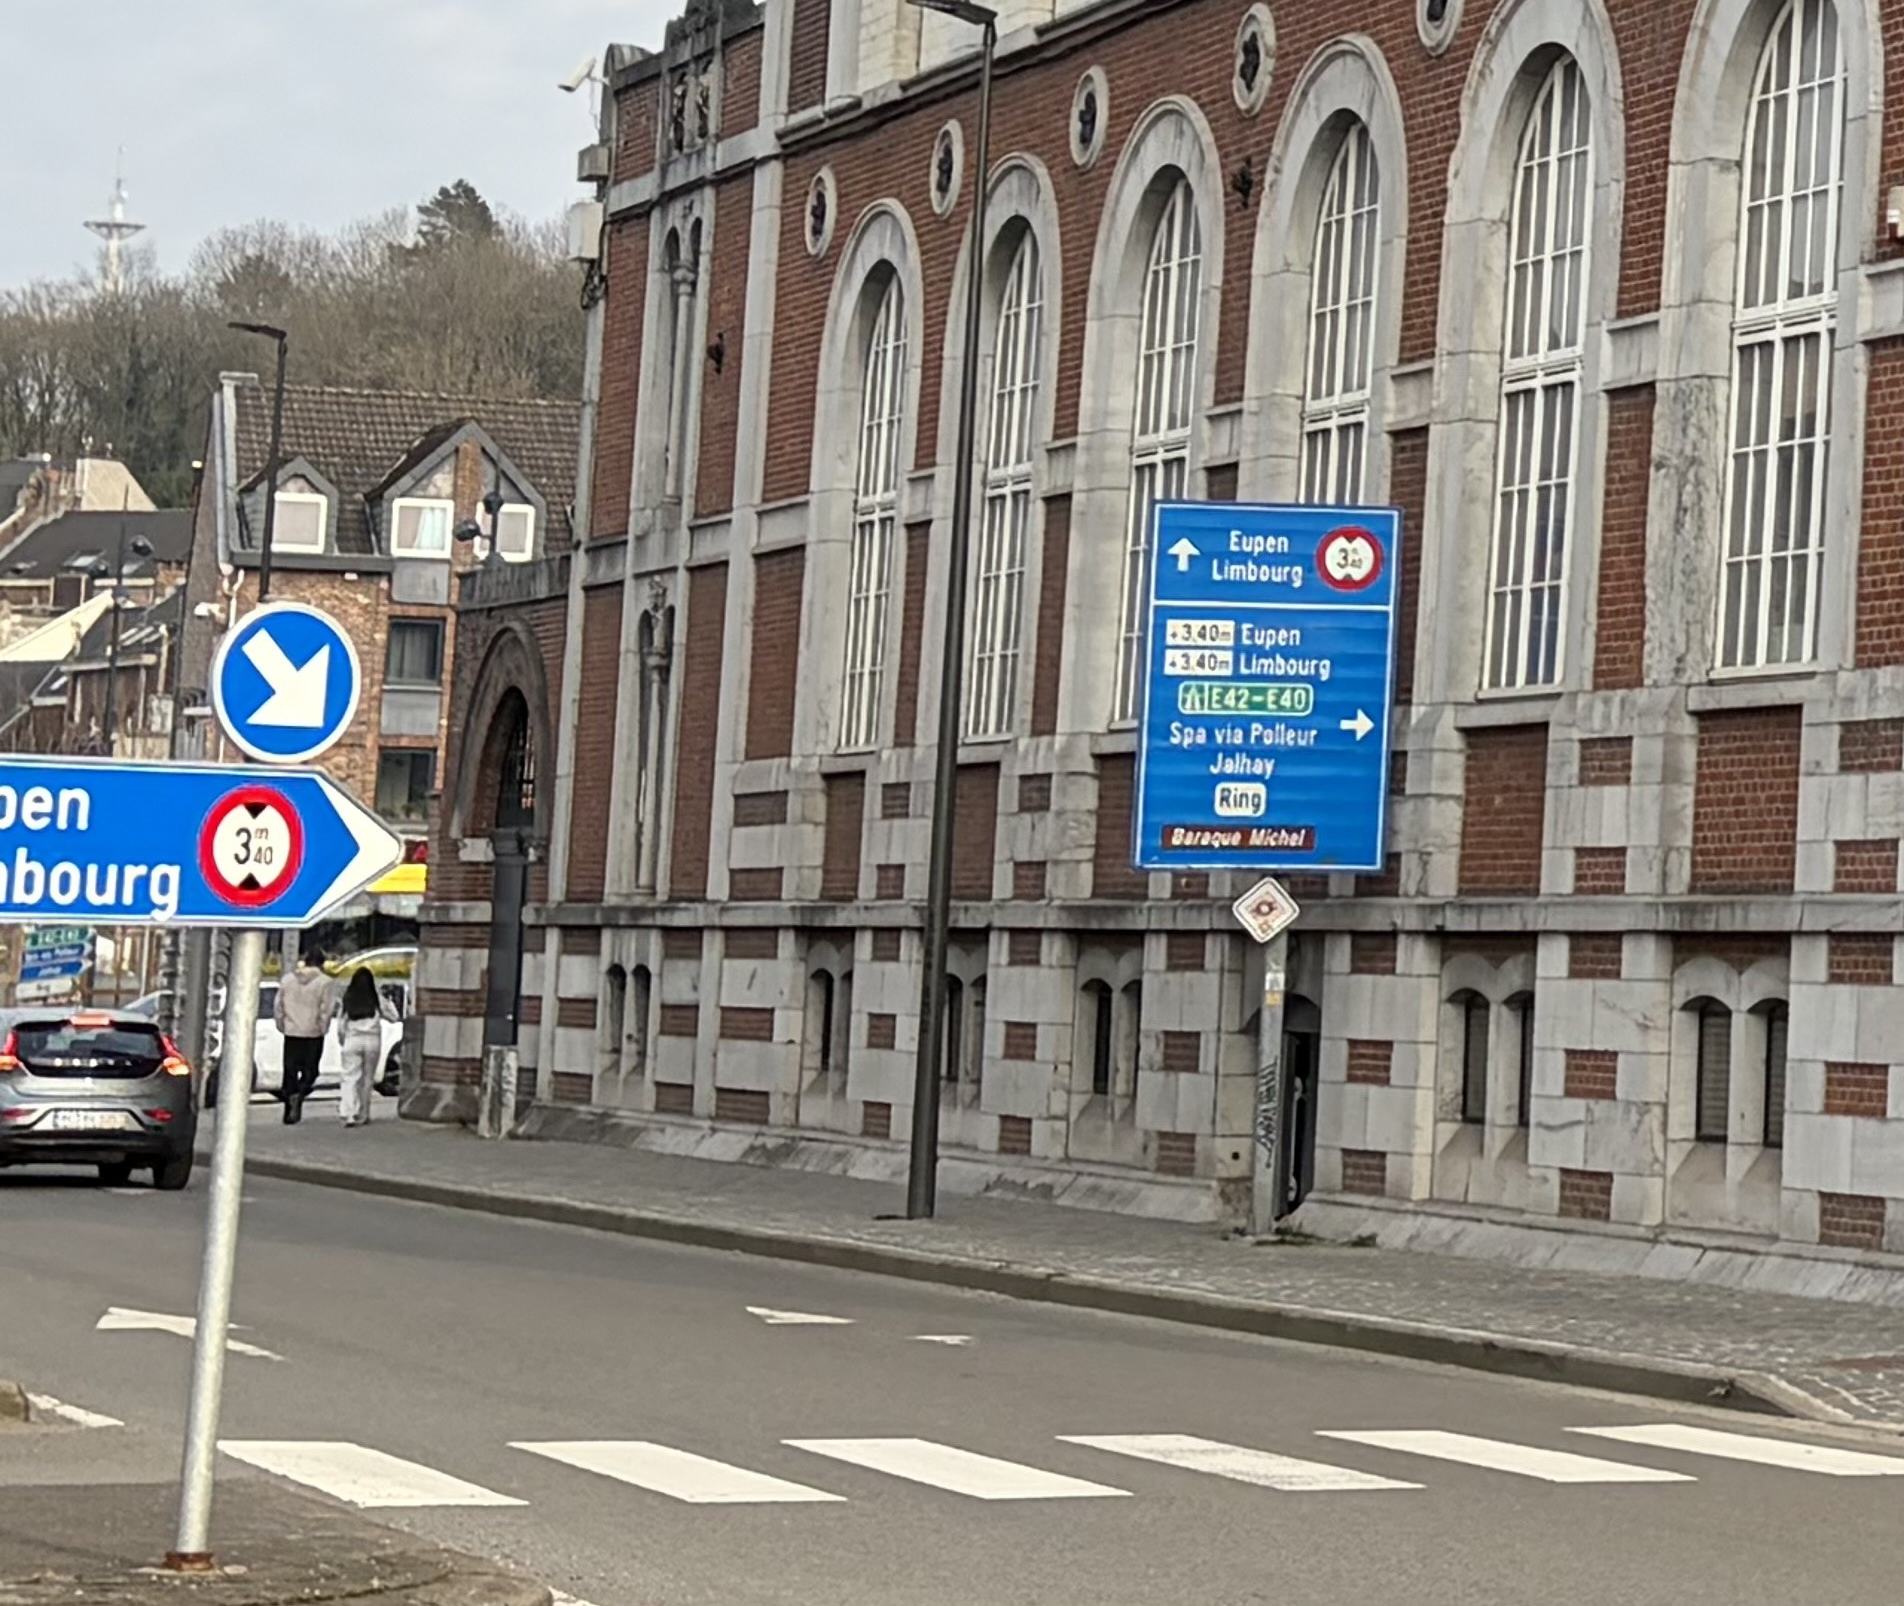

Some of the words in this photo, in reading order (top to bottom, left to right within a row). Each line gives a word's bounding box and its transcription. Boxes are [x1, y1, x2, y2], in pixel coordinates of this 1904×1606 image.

[1229, 530, 1289, 557] Eupen
[1212, 559, 1303, 588] Limbourg
[1241, 623, 1301, 649] Eupen
[1240, 653, 1331, 681] Limbourg
[1170, 721, 1207, 748] Spa
[1214, 722, 1243, 744] via
[1250, 723, 1318, 746] Polleur
[1209, 752, 1275, 779] Jalhay
[1219, 787, 1262, 814] Ring
[234, 827, 252, 865] 3
[1171, 827, 1242, 848] Baraque
[1249, 828, 1305, 846] Michel
[0, 846, 181, 921] bourg
